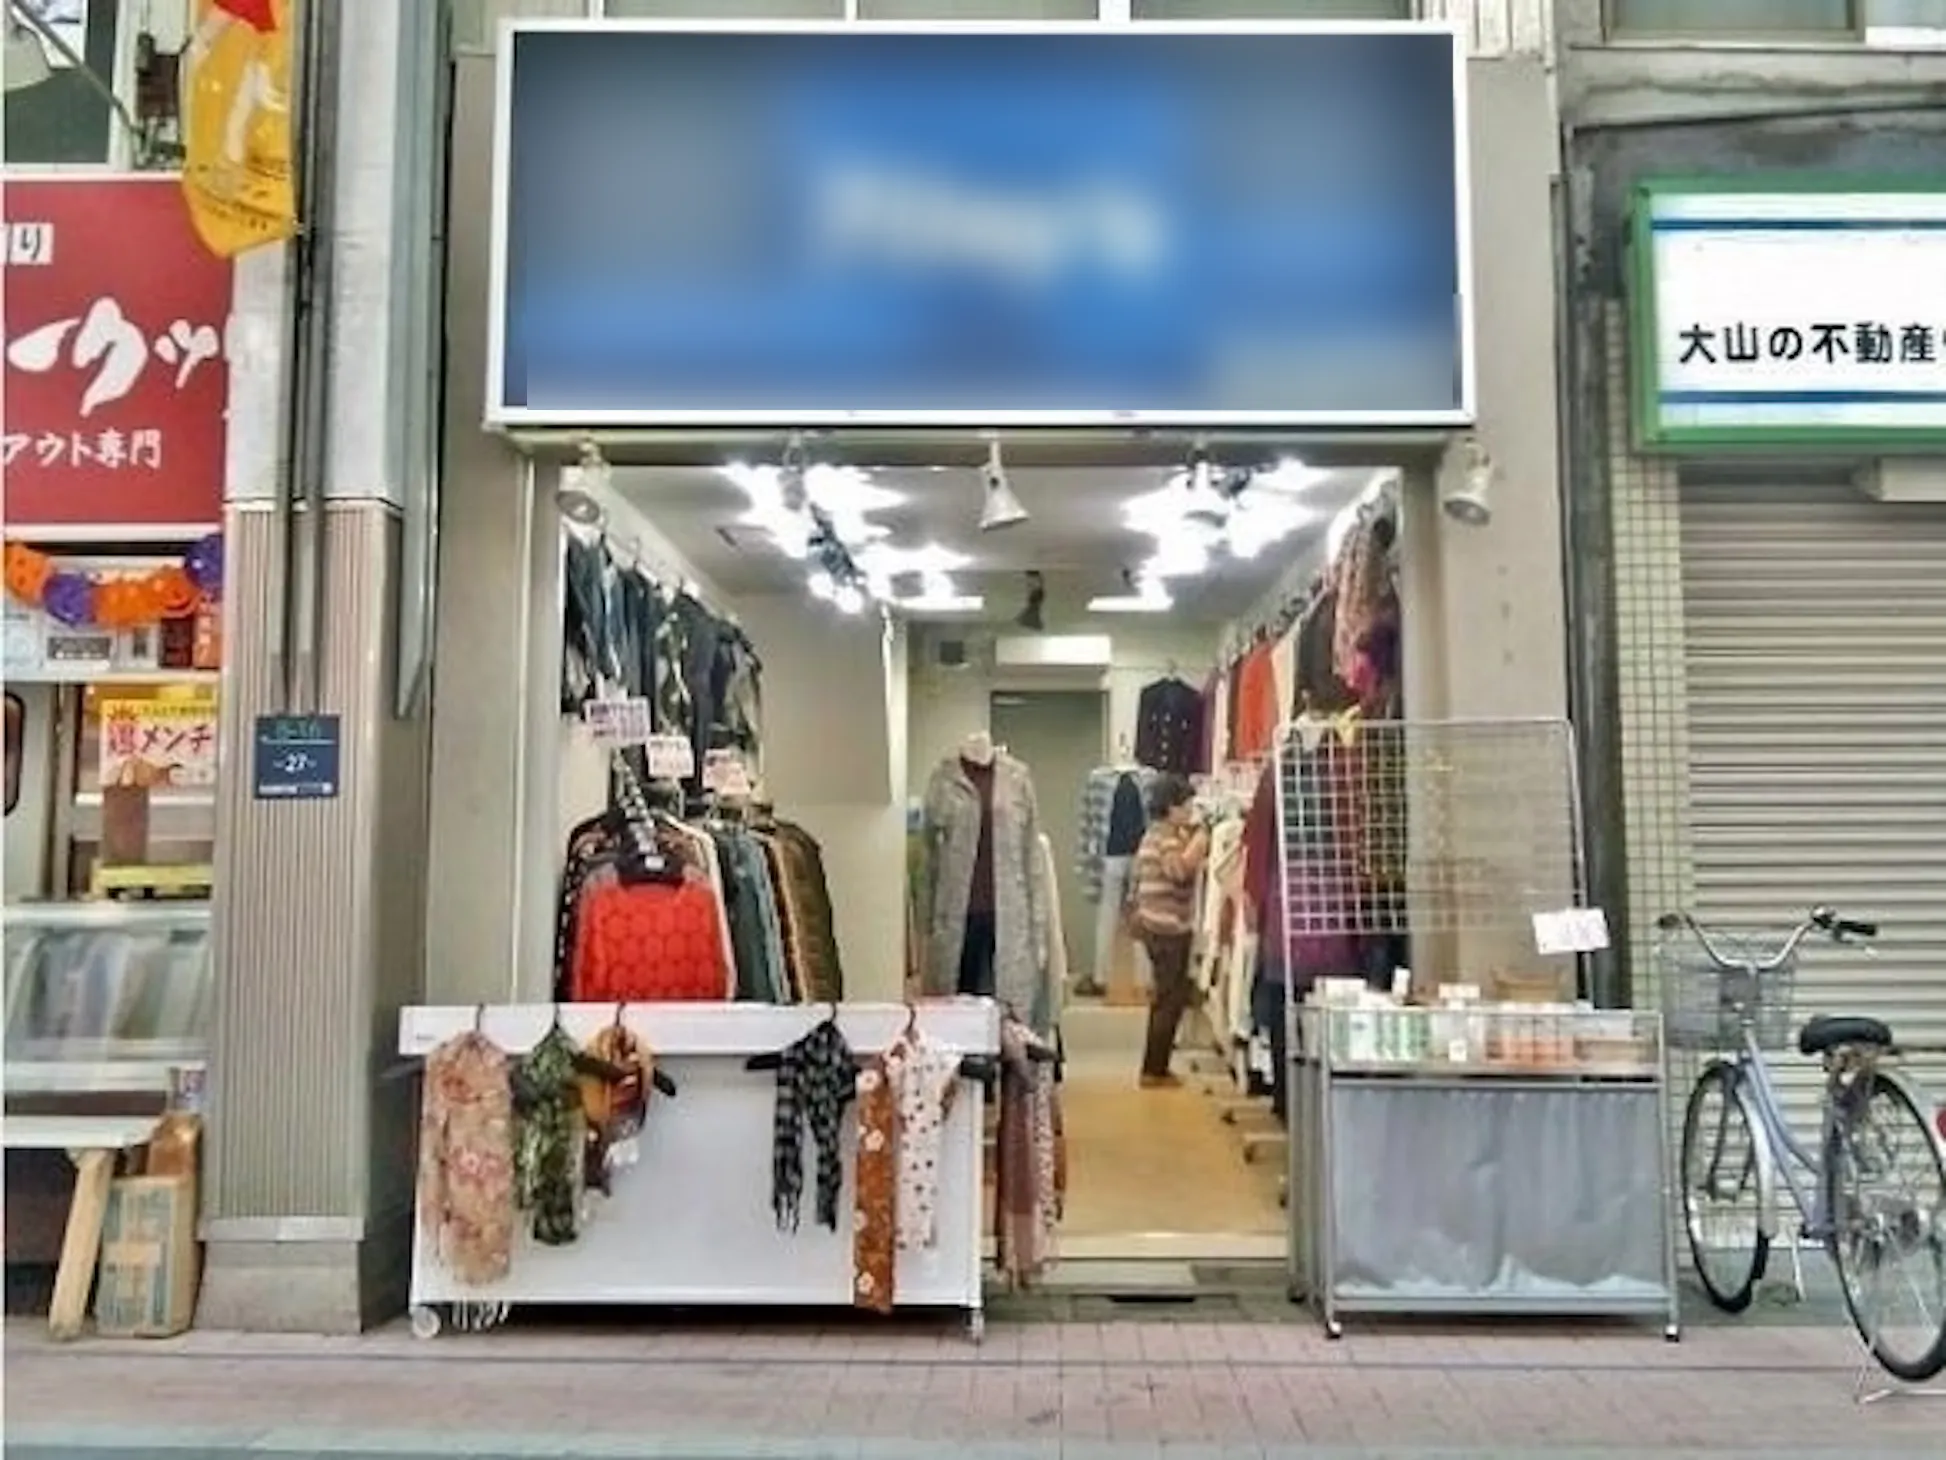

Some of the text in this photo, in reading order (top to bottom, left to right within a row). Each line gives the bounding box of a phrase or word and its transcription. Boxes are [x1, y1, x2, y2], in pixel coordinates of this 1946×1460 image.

[1678, 320, 1946, 364] 大山の不動産
